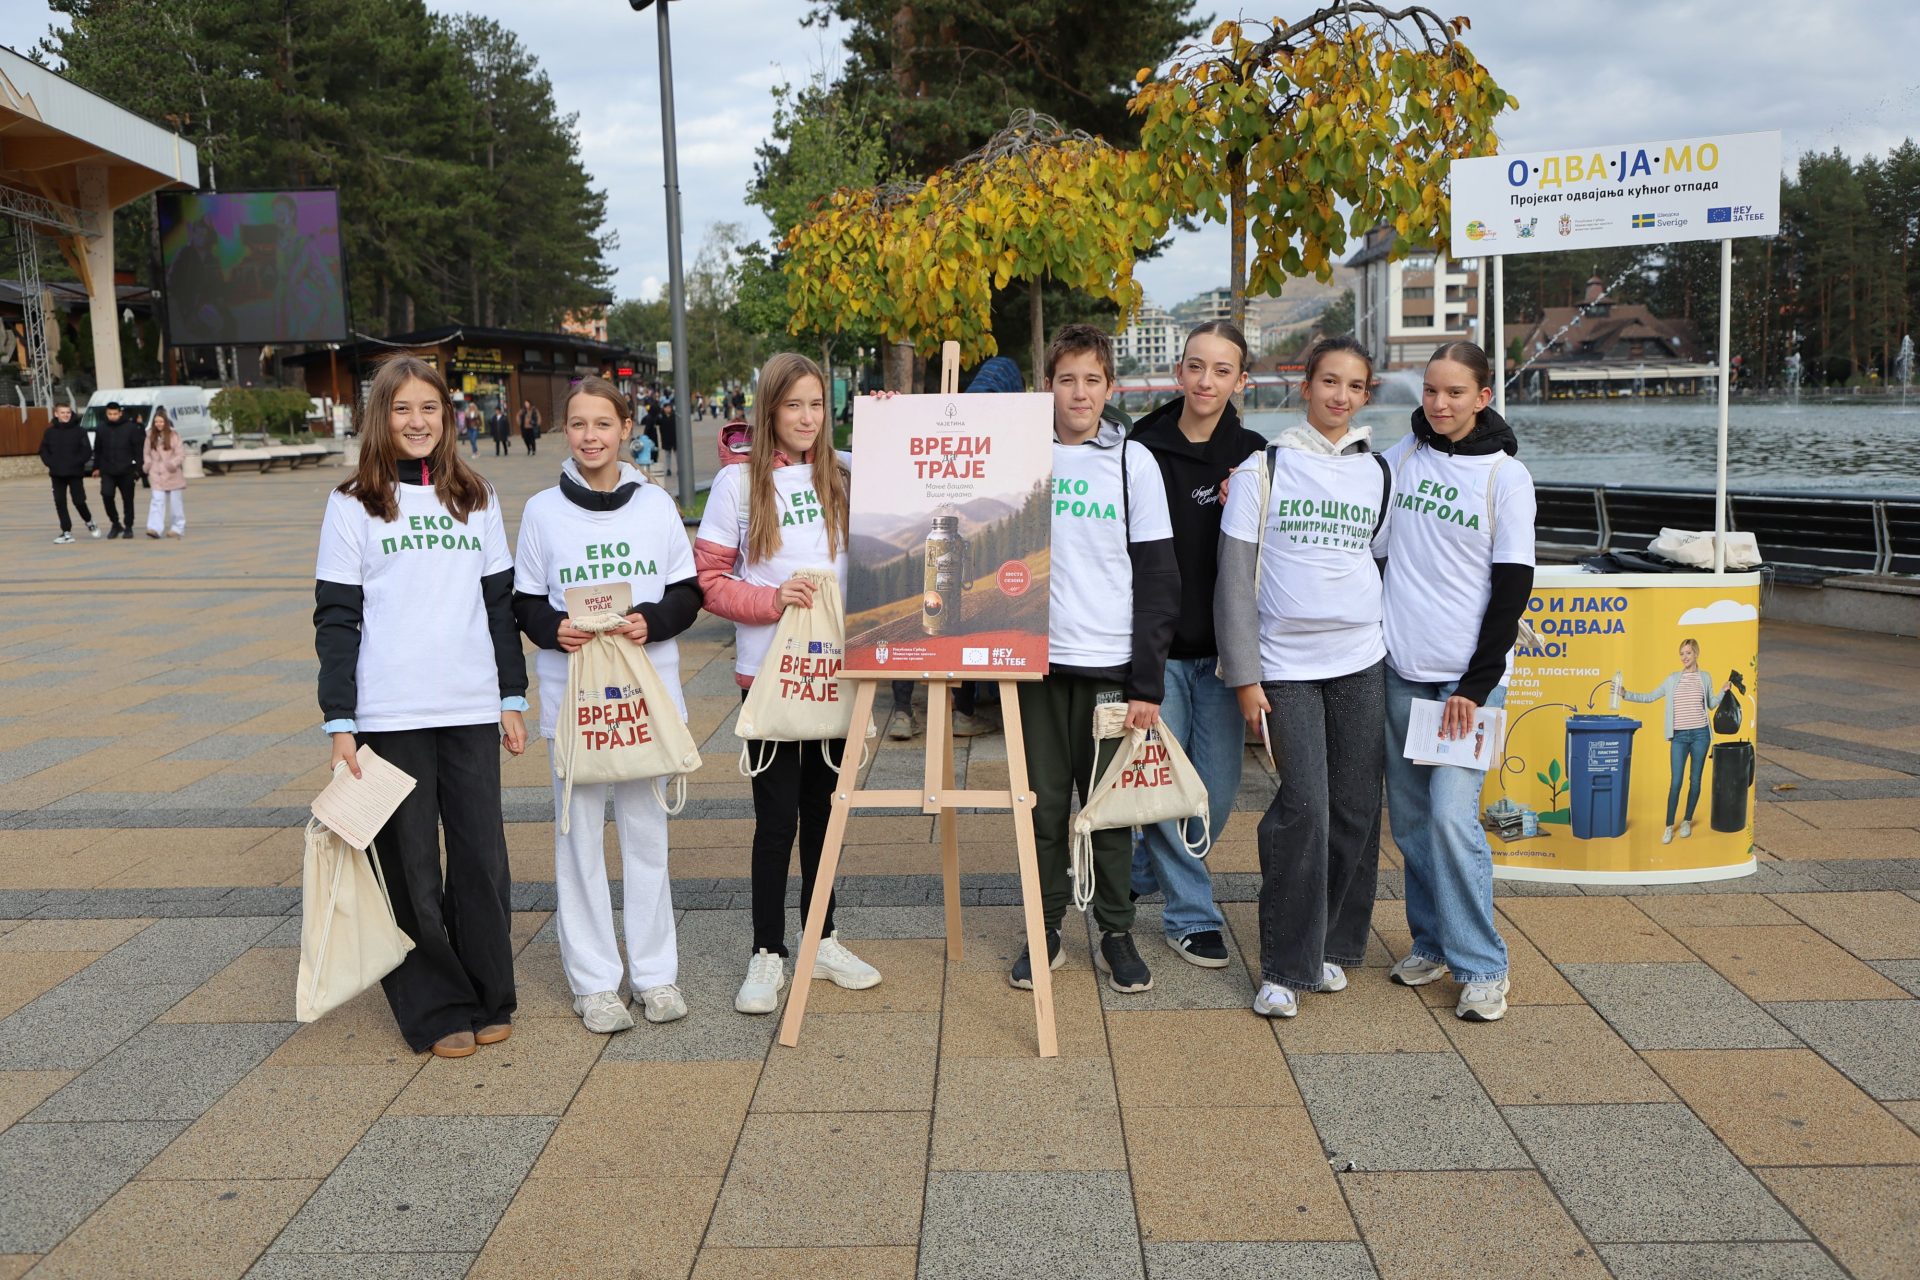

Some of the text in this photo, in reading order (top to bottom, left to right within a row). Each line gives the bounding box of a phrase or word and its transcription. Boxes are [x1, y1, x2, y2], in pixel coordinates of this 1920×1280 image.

[1510, 181, 1719, 207] Пројекат одвајања кућног отпада
[1733, 206, 1752, 214] #ЕУ
[1733, 213, 1765, 222] ЗА ТЕБЕ
[1657, 218, 1688, 228] Sverige
[910, 436, 991, 458] ВРЕДИ
[914, 460, 985, 479] ТРАЈЕ
[791, 490, 817, 507] ЕК
[1417, 479, 1458, 502] ЕКО
[1394, 493, 1479, 530] ПАТРОЛА
[409, 515, 453, 531] ЕКО
[382, 534, 482, 555] ПАТРОЛА
[586, 542, 631, 561] ЕКО
[559, 560, 657, 584] ПАТРОЛА
[584, 594, 613, 606] ВРЕДИ
[587, 602, 613, 612] ТРАЈЕ
[1550, 597, 1564, 613] И
[1569, 596, 1628, 613] ЛАКО
[1541, 619, 1626, 637] ОДВАЈА
[992, 648, 1013, 658] #ЕУ
[992, 658, 1026, 666] ЗА ТЕБЕ
[780, 655, 842, 680] ВРЕДИ
[1538, 667, 1600, 676] пластика
[780, 678, 839, 702] ТРАЈЕ
[1510, 679, 1540, 687] етал
[578, 697, 649, 726] ВРЕДИ
[582, 723, 652, 750] ТРАЈЕ
[1112, 767, 1173, 788] РАЈЕ
[1491, 850, 1556, 858] www.odvajamo.rs
